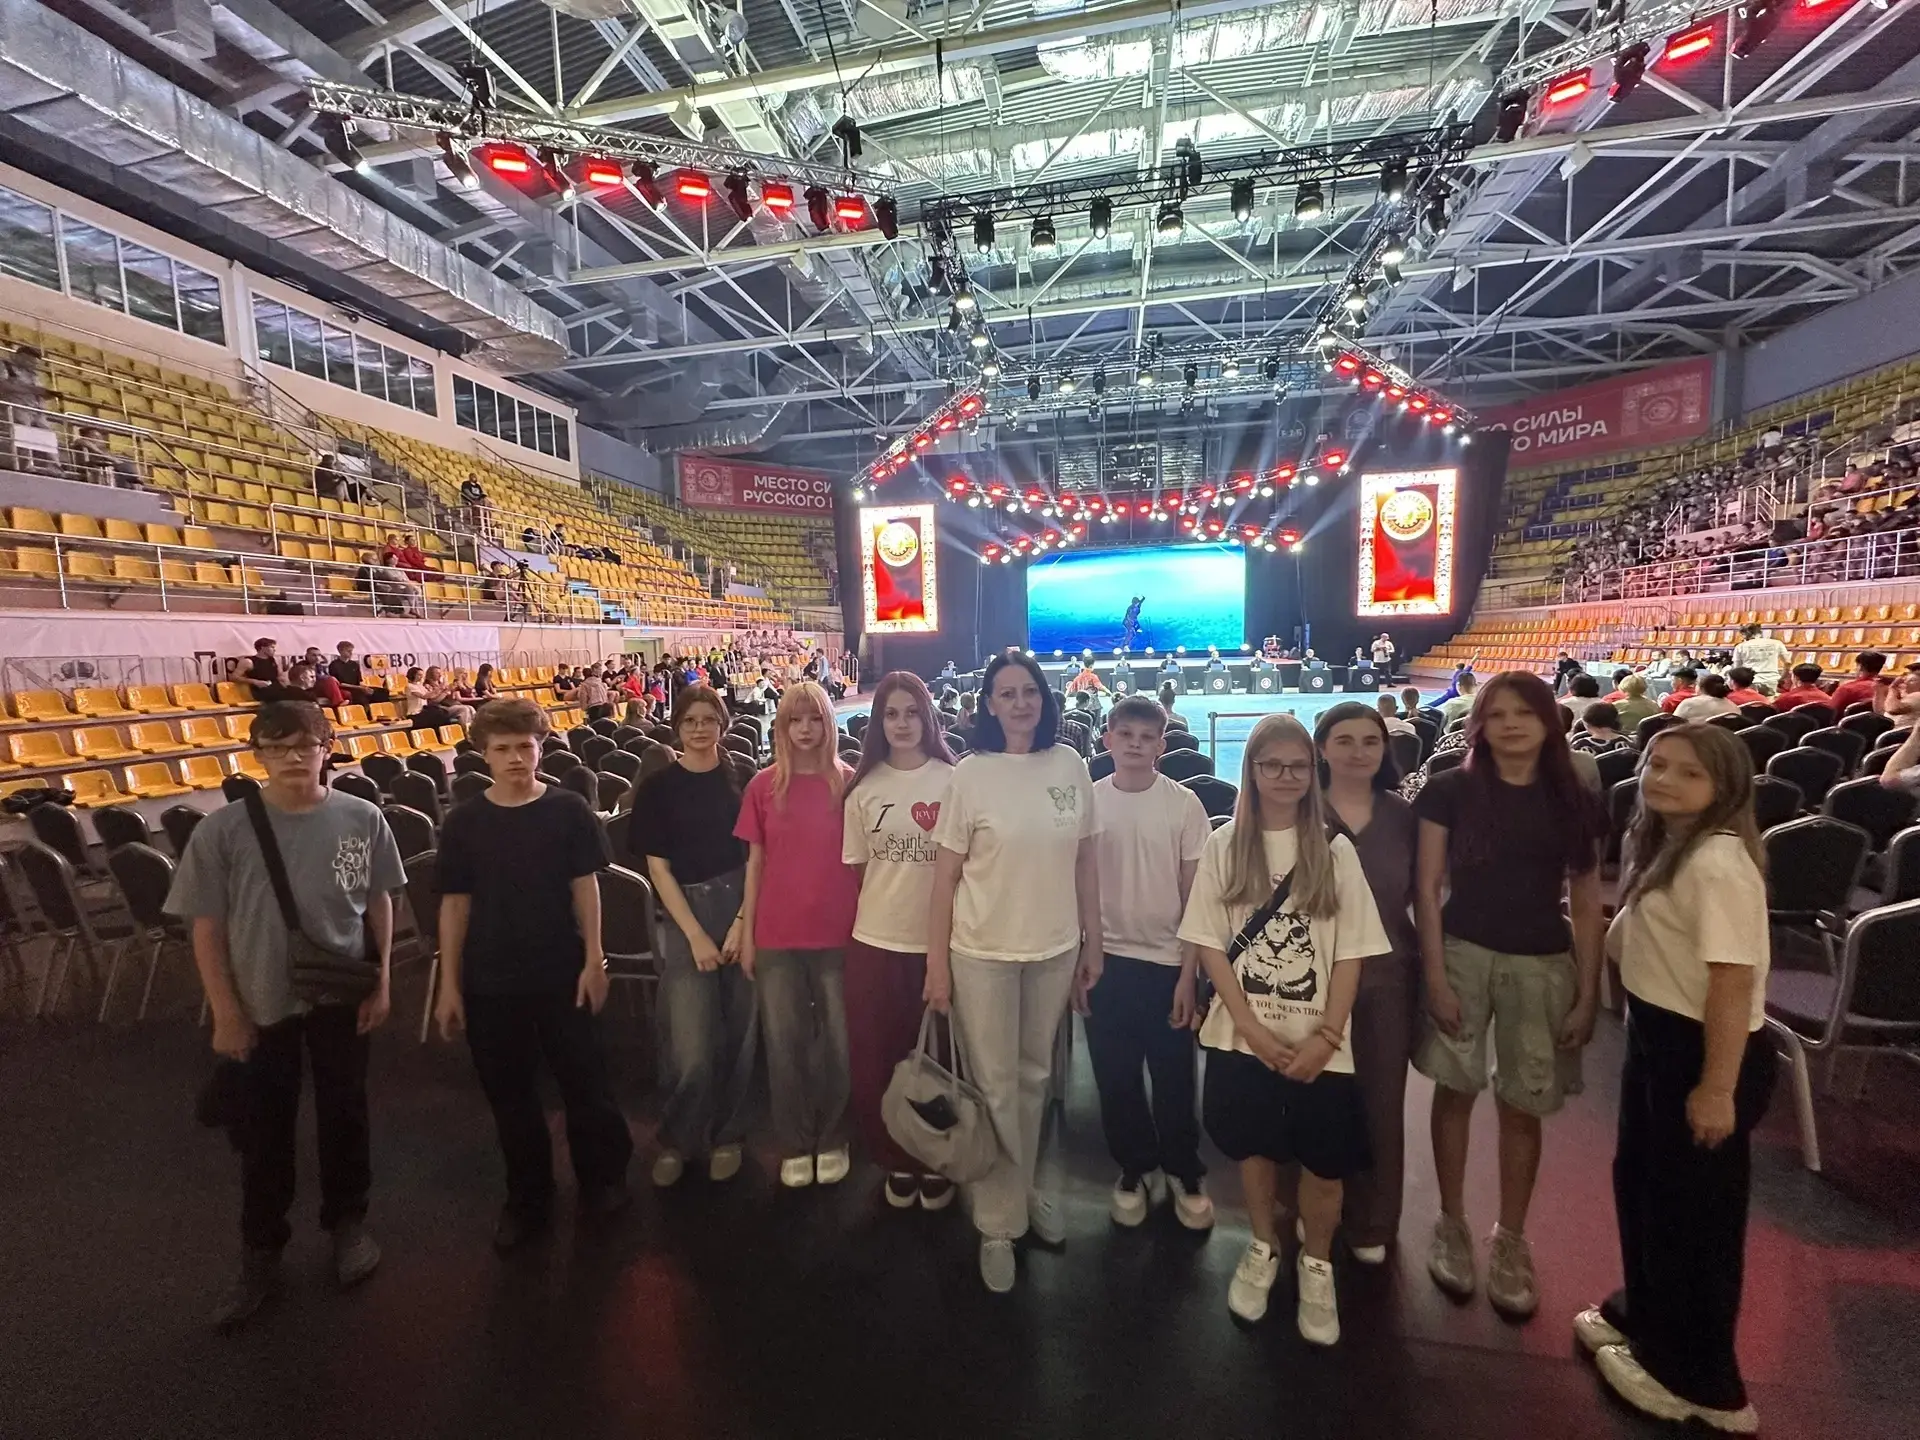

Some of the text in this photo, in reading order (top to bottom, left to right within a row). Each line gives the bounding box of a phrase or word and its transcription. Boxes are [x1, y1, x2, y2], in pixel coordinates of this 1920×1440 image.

[1513, 405, 1582, 433] СИЛЫ
[1537, 420, 1608, 448] МИРА
[753, 475, 809, 492] МЕСТО
[743, 489, 826, 508] РУССКОГО
[377, 659, 384, 668] 4
[871, 803, 895, 833] I
[885, 832, 929, 850] Saint-
[1256, 999, 1273, 1010] YOU
[1277, 1003, 1301, 1014] SEEN
